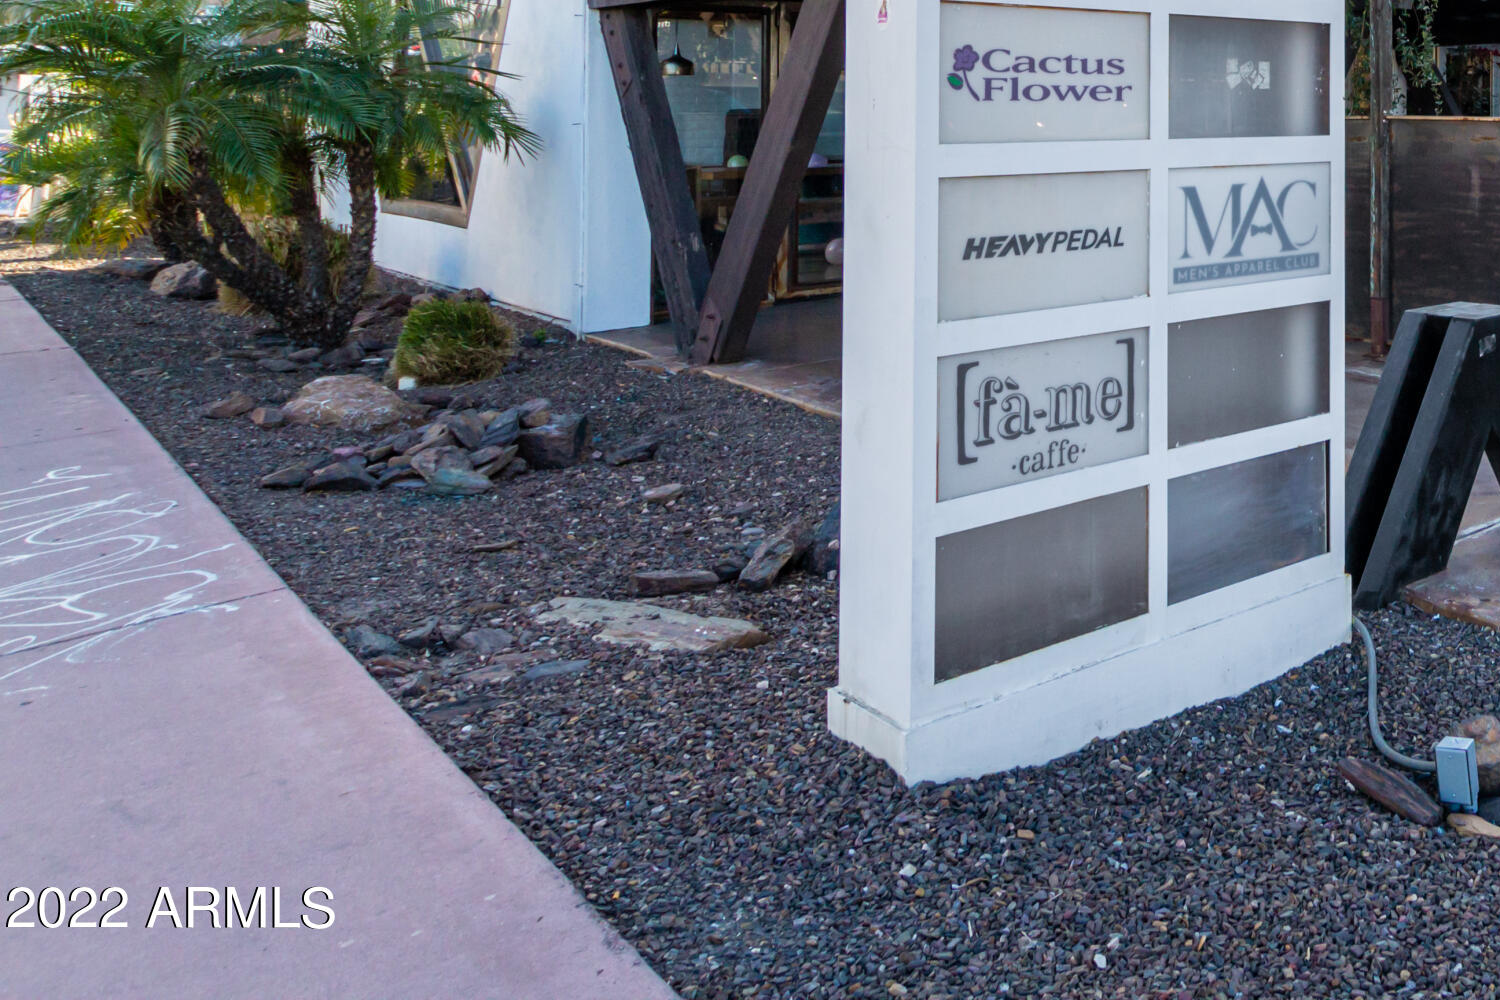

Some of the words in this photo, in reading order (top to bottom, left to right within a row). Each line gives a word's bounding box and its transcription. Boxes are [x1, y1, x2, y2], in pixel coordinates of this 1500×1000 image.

[981, 48, 1125, 76] Cactus
[981, 77, 1133, 102] Flower
[1178, 176, 1318, 260] MAC
[1177, 266, 1220, 282] MEN'S
[1225, 260, 1280, 277] APPAREL
[1284, 254, 1316, 268] CLUB
